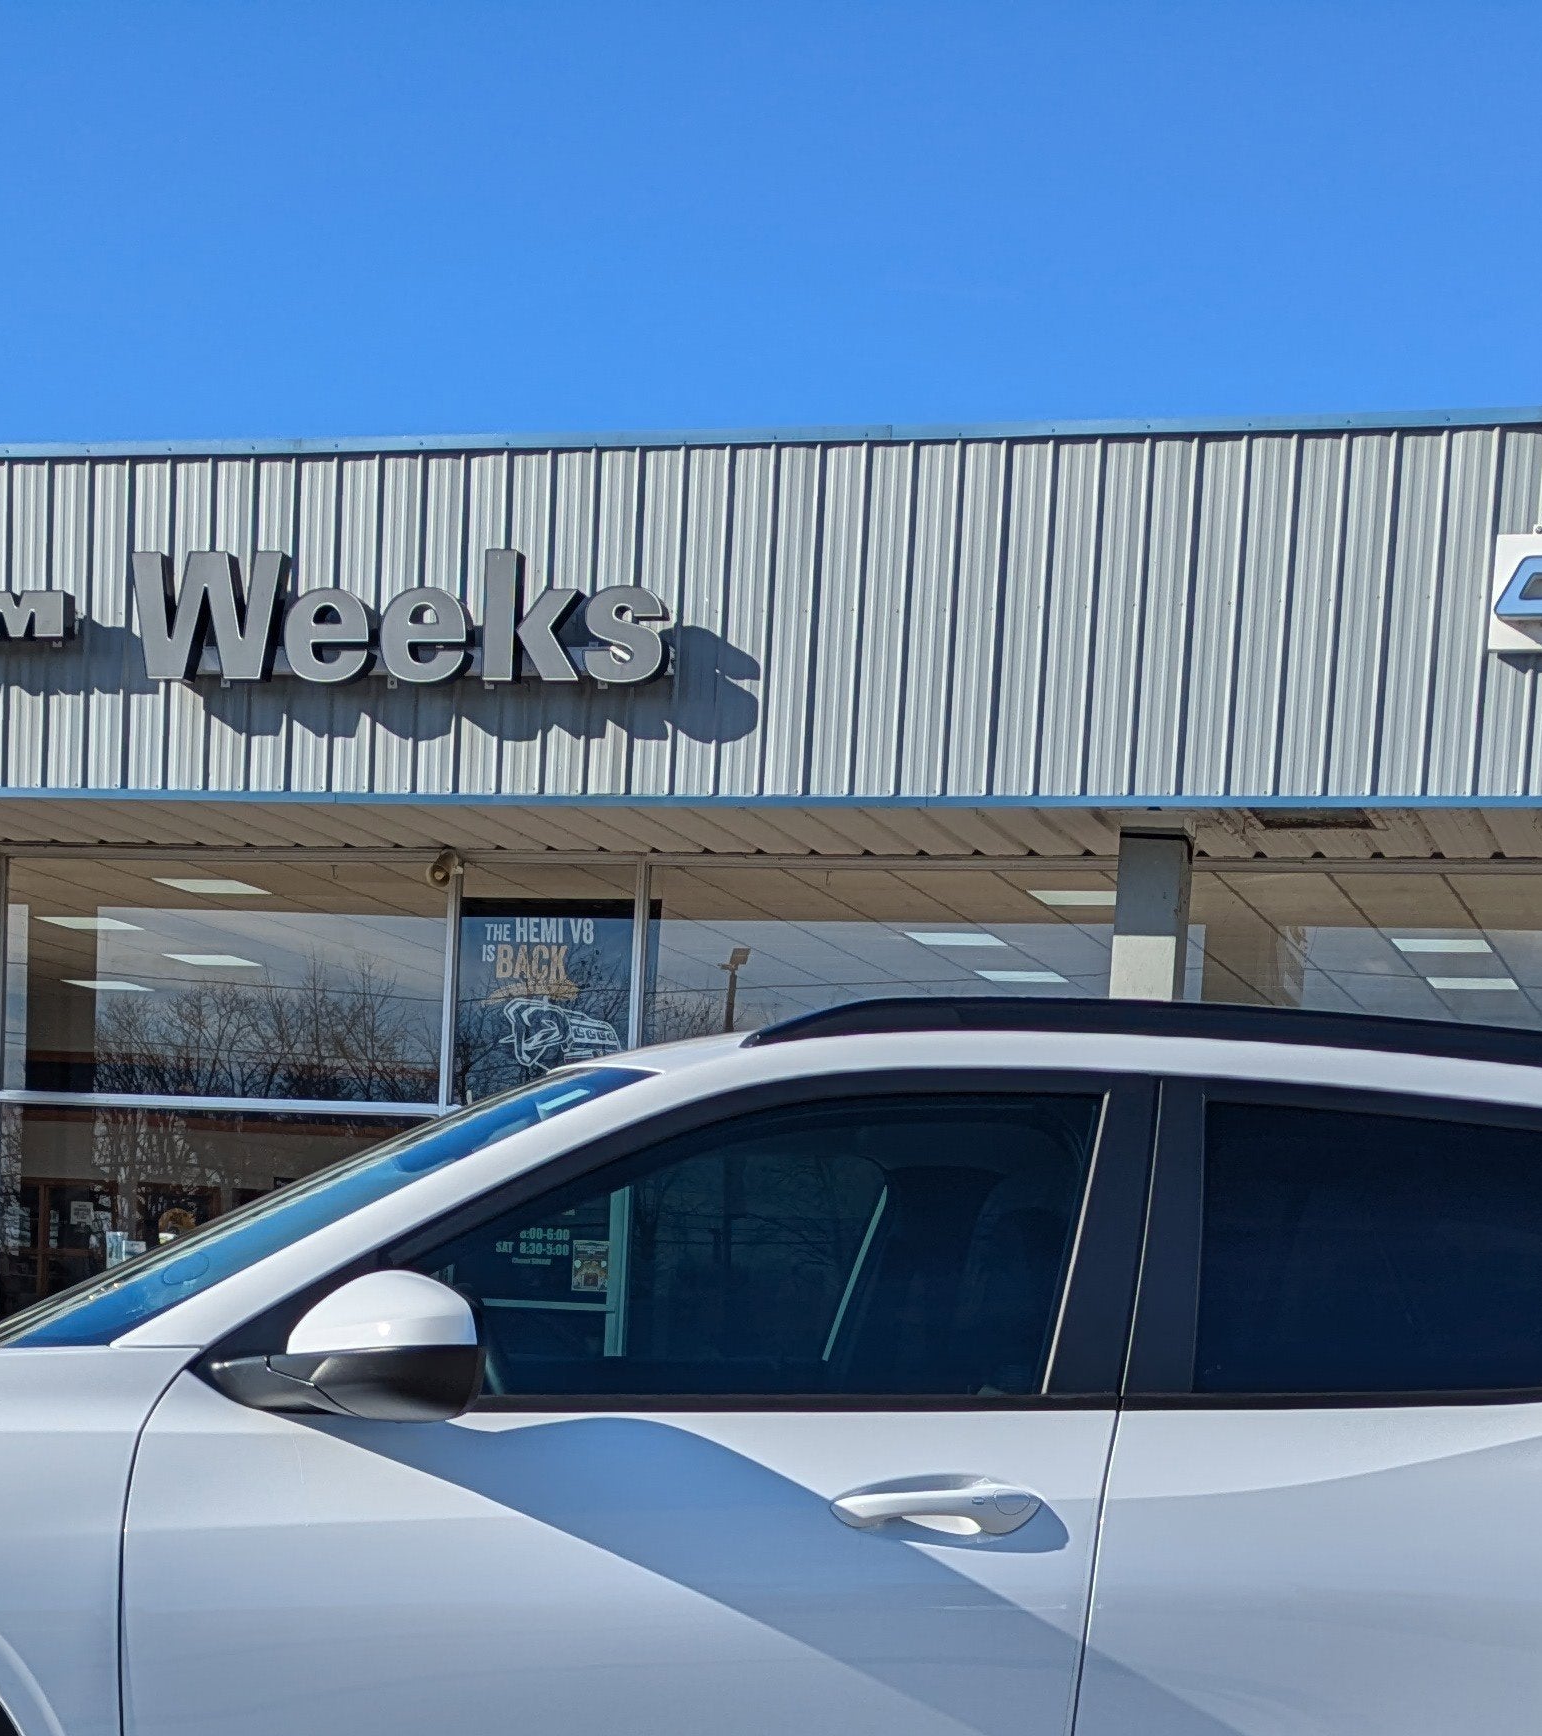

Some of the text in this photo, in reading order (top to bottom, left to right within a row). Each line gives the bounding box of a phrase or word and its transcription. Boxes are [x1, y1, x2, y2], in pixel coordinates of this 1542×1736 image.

[132, 548, 670, 683] Weeks
[485, 917, 595, 945] THE HEMI V8
[482, 944, 569, 981] IS BACK
[496, 1241, 514, 1253] SAT
